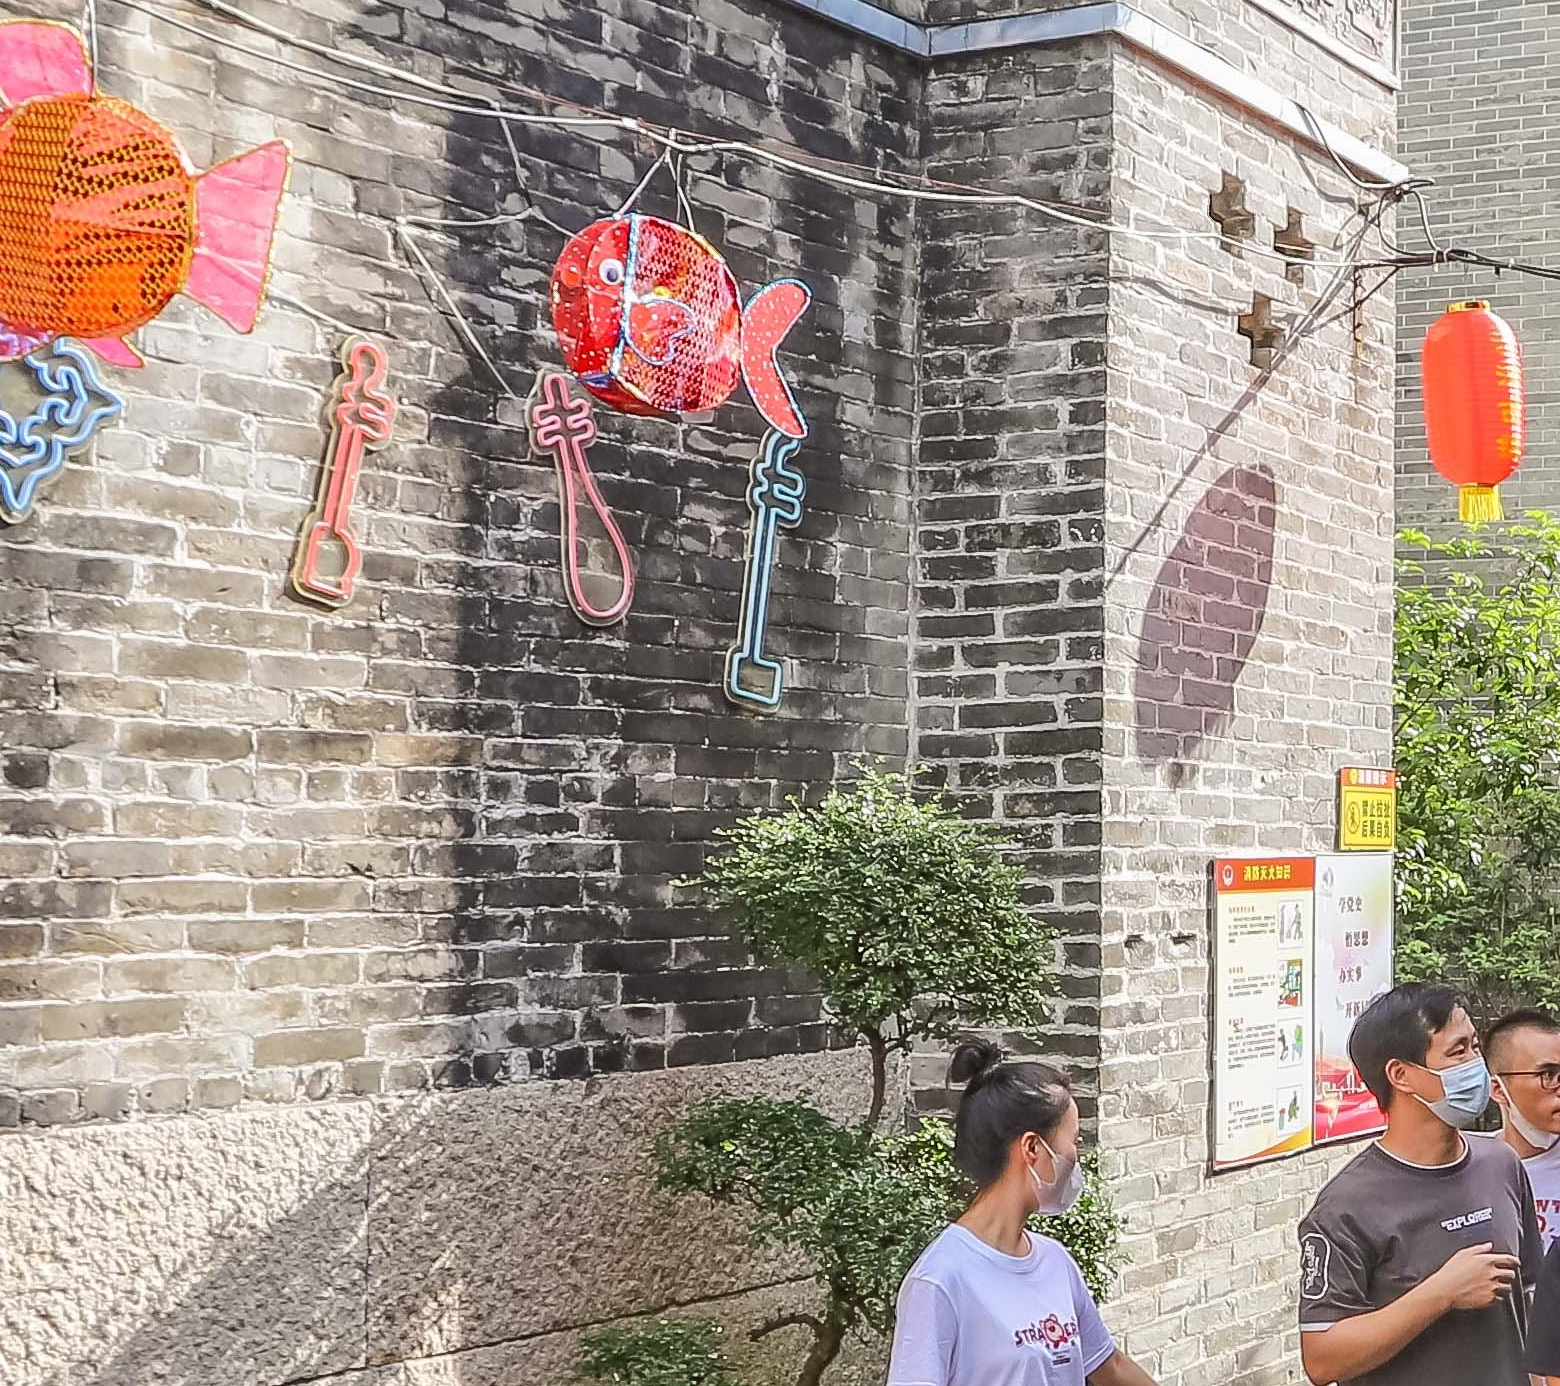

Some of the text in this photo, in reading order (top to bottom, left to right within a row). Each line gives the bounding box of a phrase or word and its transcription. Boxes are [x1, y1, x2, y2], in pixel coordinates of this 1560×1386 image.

[1362, 819, 1391, 839] 后果自负
[1243, 864, 1292, 882] 消防灭火知识
[1338, 895, 1363, 913] 学党史
